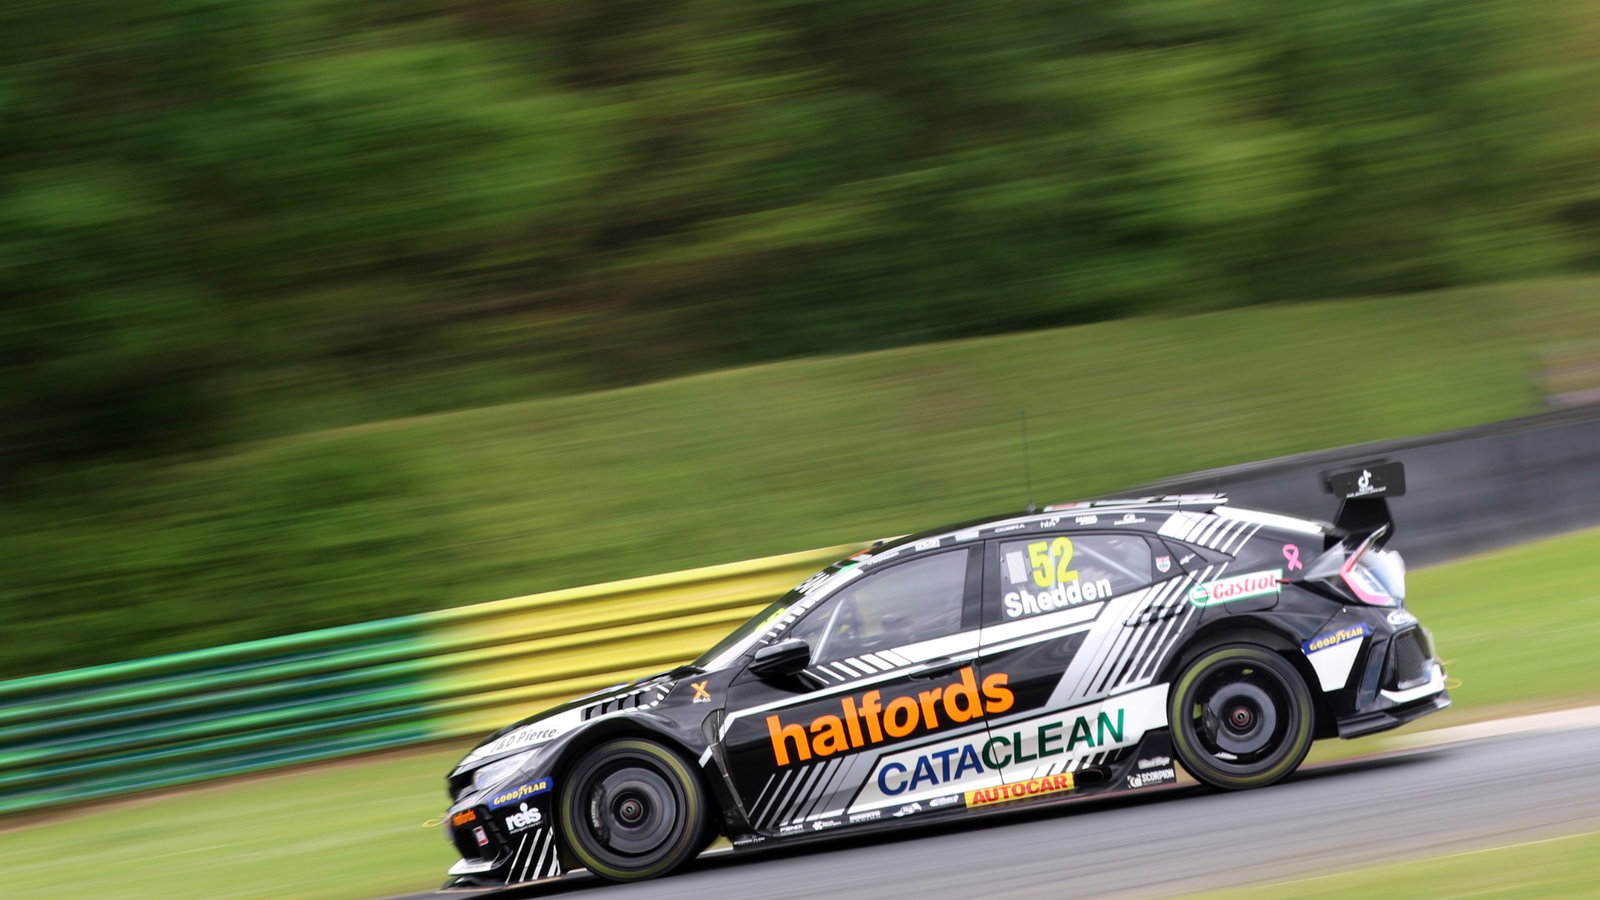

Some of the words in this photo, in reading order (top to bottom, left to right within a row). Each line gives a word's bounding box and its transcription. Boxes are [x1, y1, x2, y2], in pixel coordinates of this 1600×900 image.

[1028, 536, 1080, 588] 52
[1004, 577, 1113, 618] Shedden
[1212, 574, 1276, 600] Castrol
[1309, 626, 1364, 651] GOODYEAR
[766, 666, 1015, 767] halfords
[516, 728, 557, 744] Pierce
[877, 708, 1125, 796] CATACLEAN
[972, 774, 1068, 806] AUTOCAR
[1141, 768, 1175, 783] SCORPION
[493, 781, 547, 806] GOODYEAR
[505, 802, 542, 831] reis
